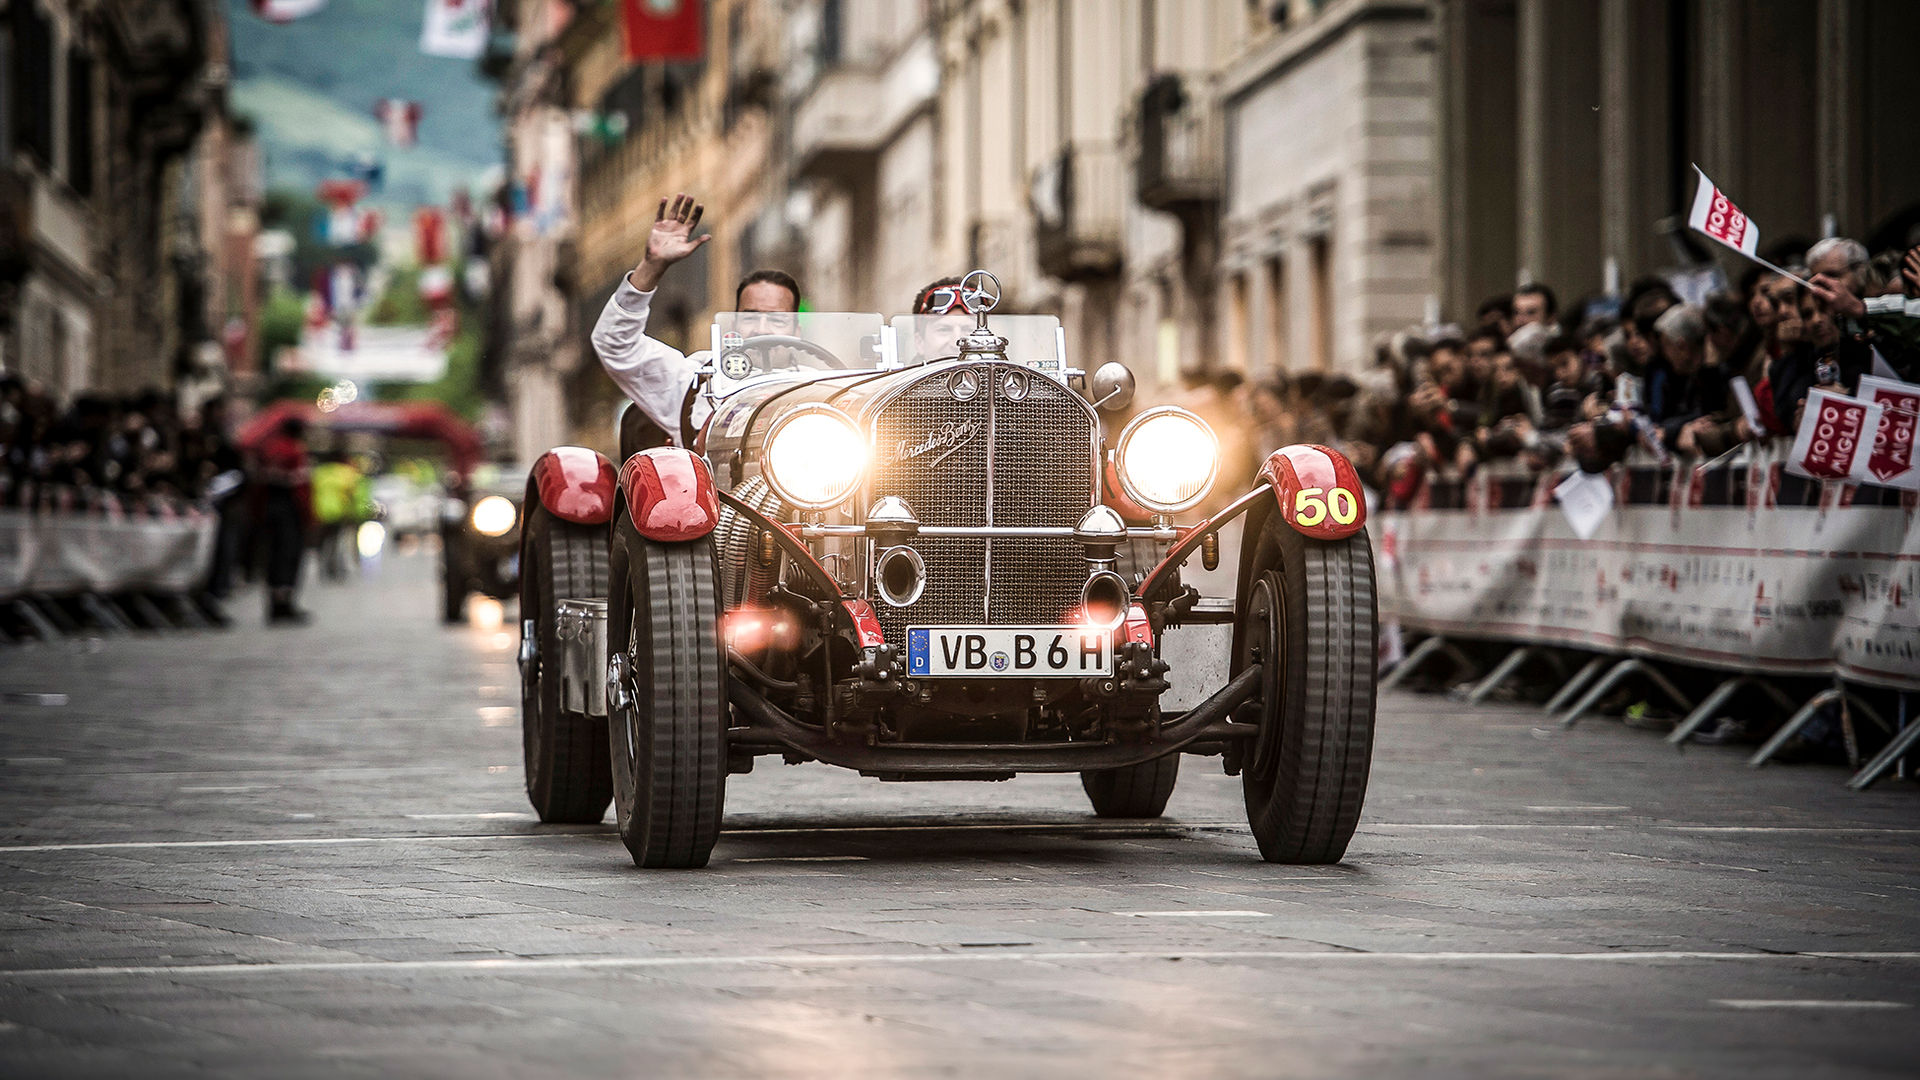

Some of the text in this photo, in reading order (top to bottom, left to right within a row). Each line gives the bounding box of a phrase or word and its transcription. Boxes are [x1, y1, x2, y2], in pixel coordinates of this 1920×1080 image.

[1708, 188, 1728, 234] 100
[1811, 406, 1839, 462] 1000
[1830, 407, 1863, 475] MIGLIA
[1295, 487, 1358, 527] 50
[915, 656, 924, 668] D
